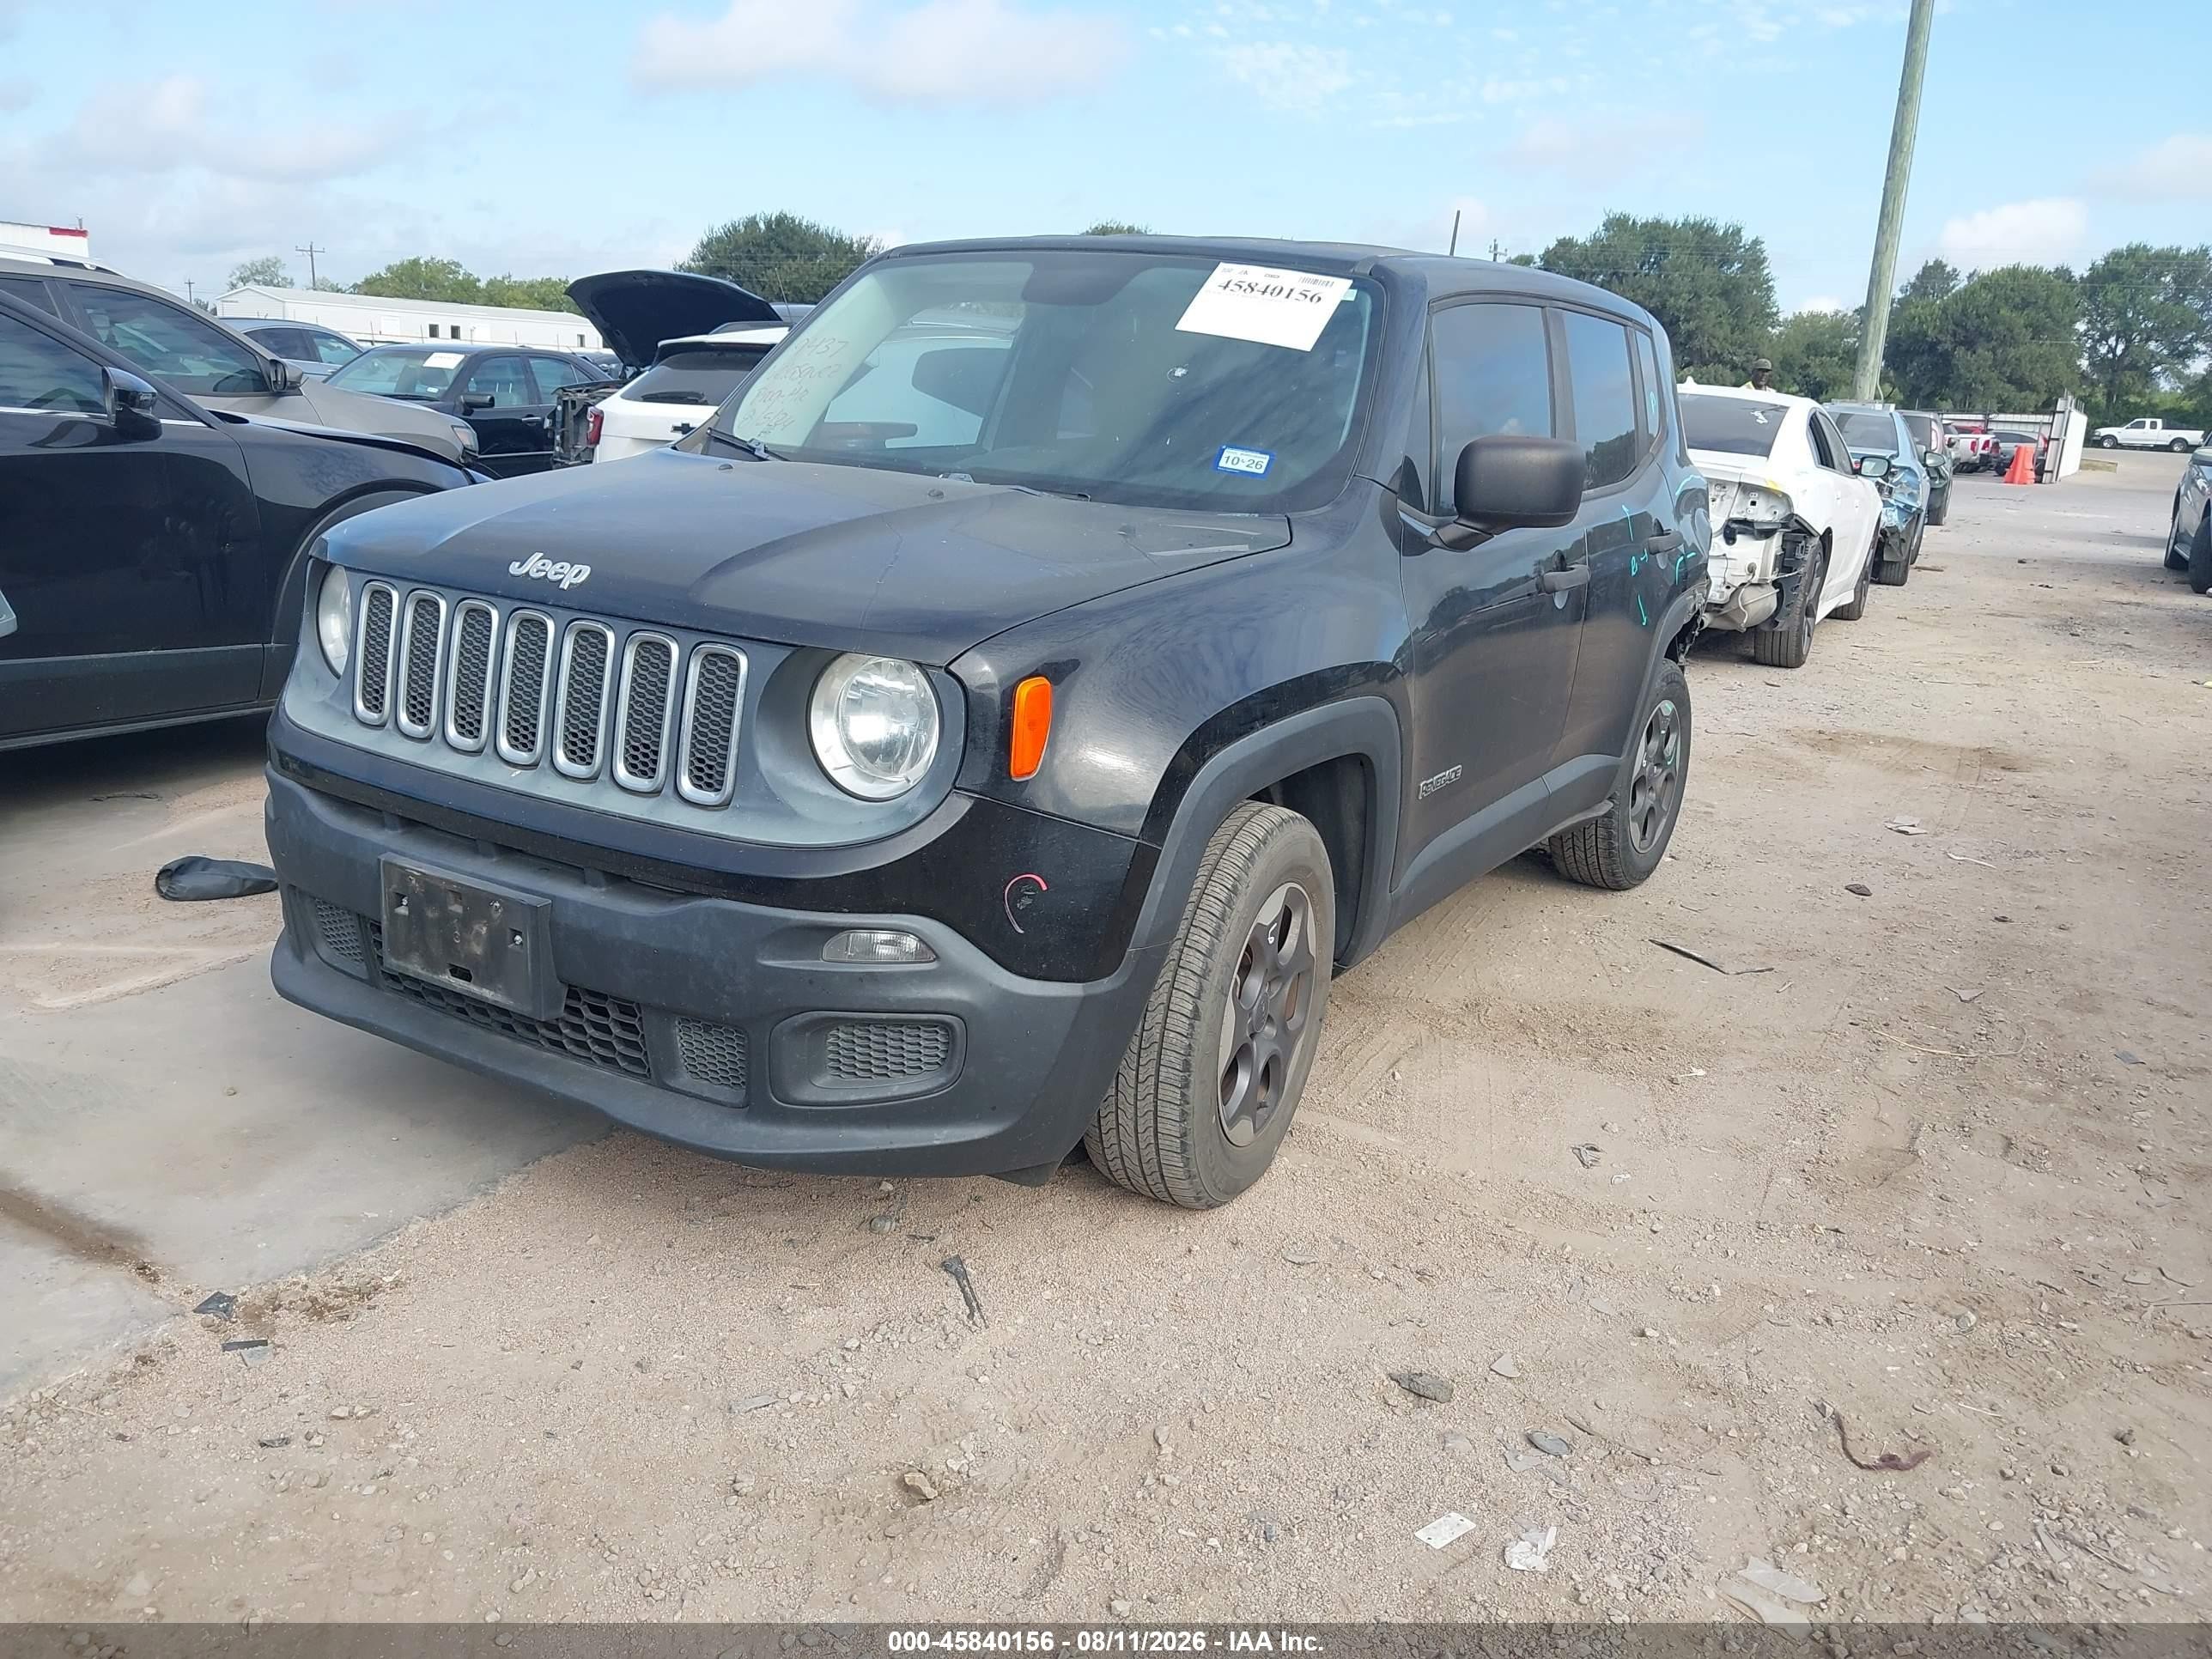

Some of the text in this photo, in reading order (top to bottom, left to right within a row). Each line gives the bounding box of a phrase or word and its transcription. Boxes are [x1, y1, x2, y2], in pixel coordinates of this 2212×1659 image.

[1218, 278, 1323, 304] 45840156
[508, 551, 591, 590] Jeep
[1418, 764, 1462, 799] RENEGADE
